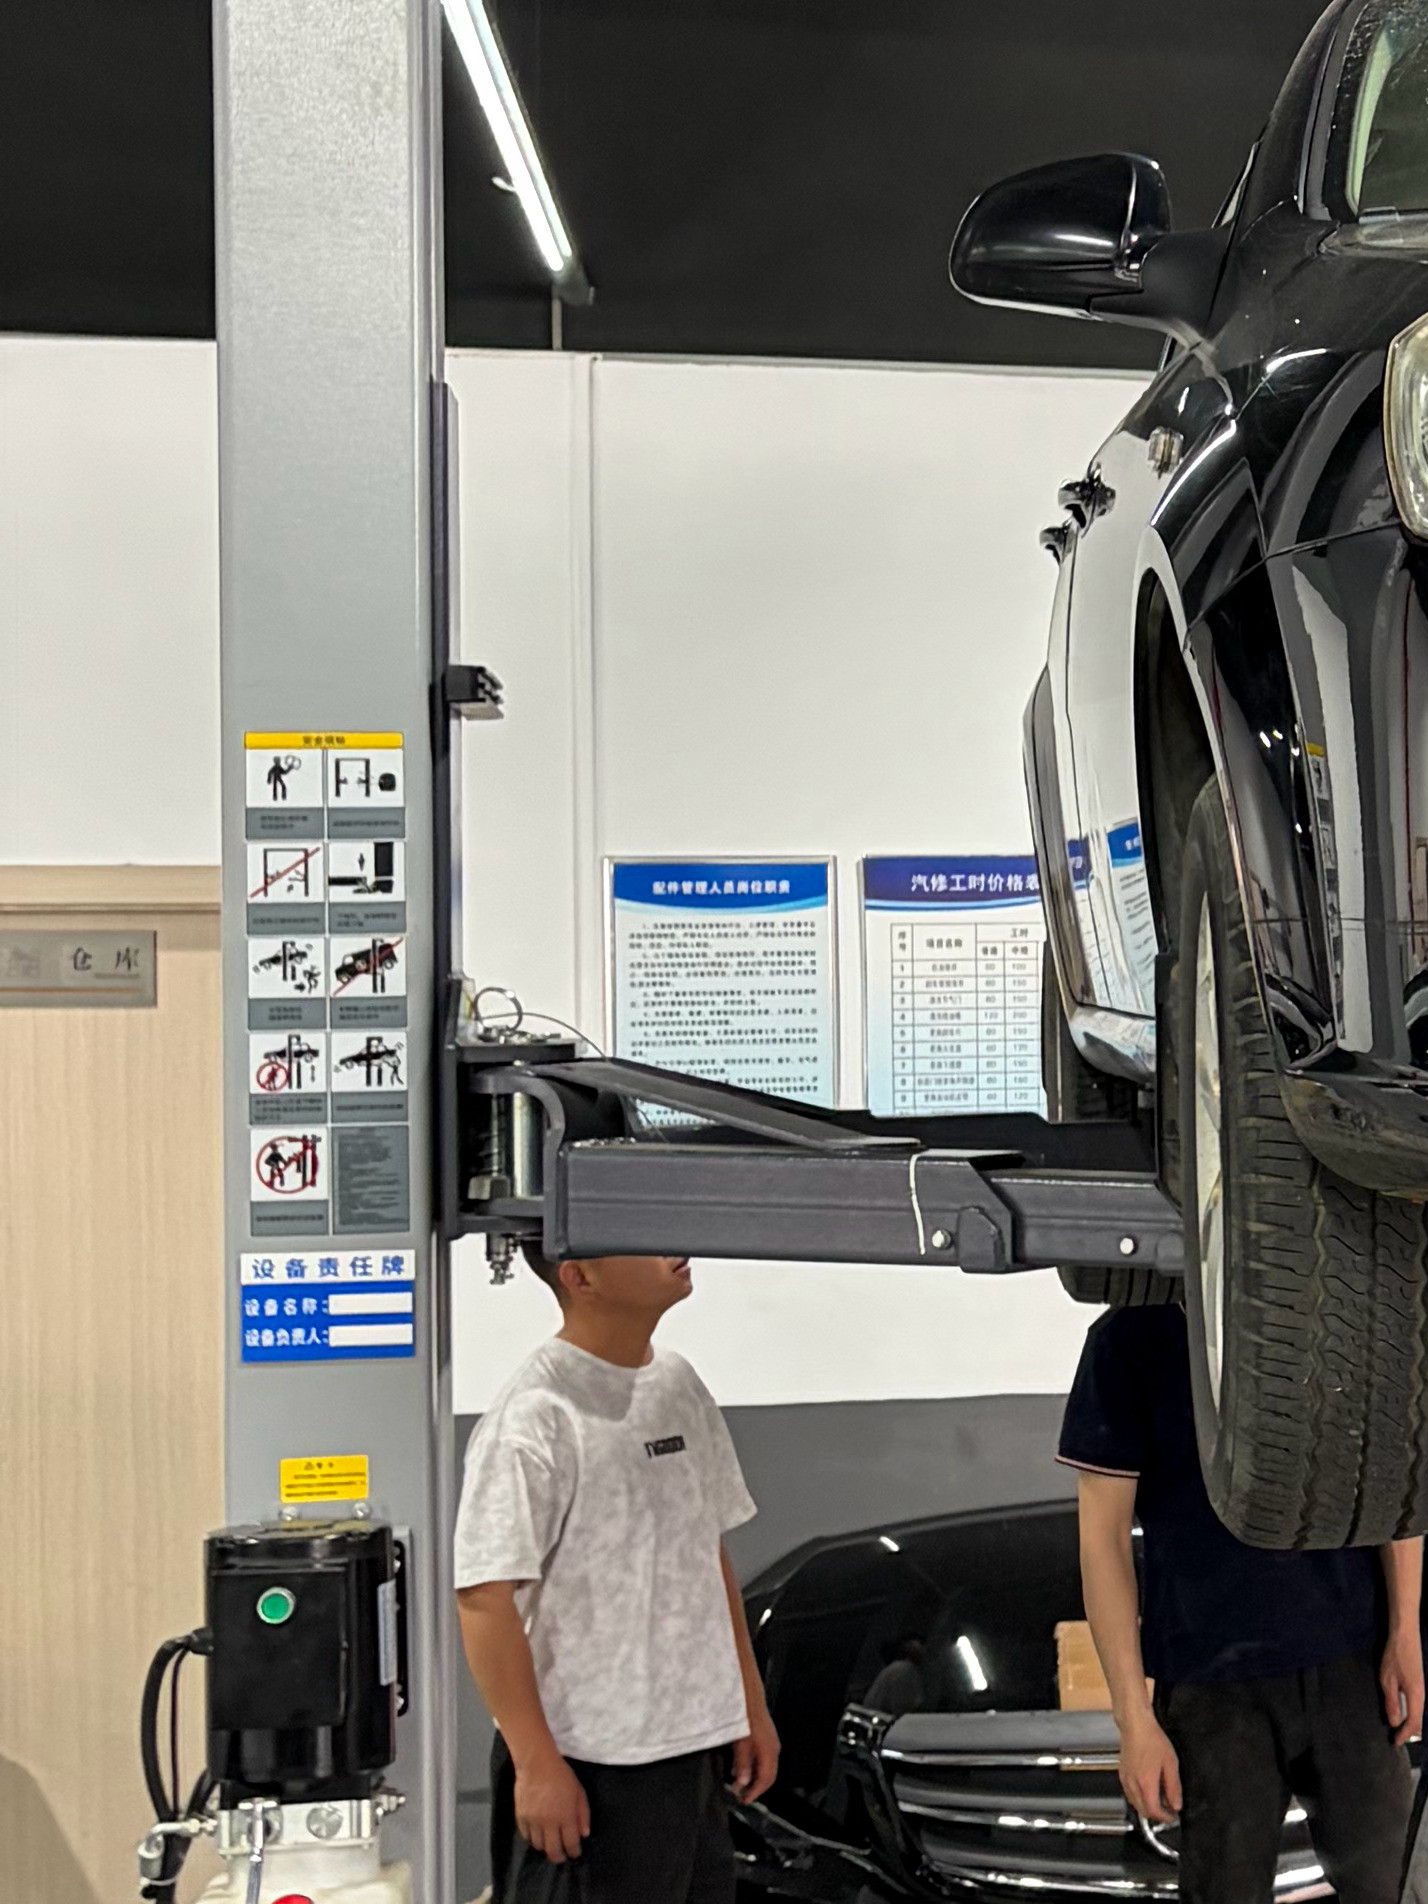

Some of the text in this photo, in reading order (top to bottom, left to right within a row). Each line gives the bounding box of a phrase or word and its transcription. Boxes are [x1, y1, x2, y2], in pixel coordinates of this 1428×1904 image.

[252, 1255, 405, 1279] 设备责任牌
